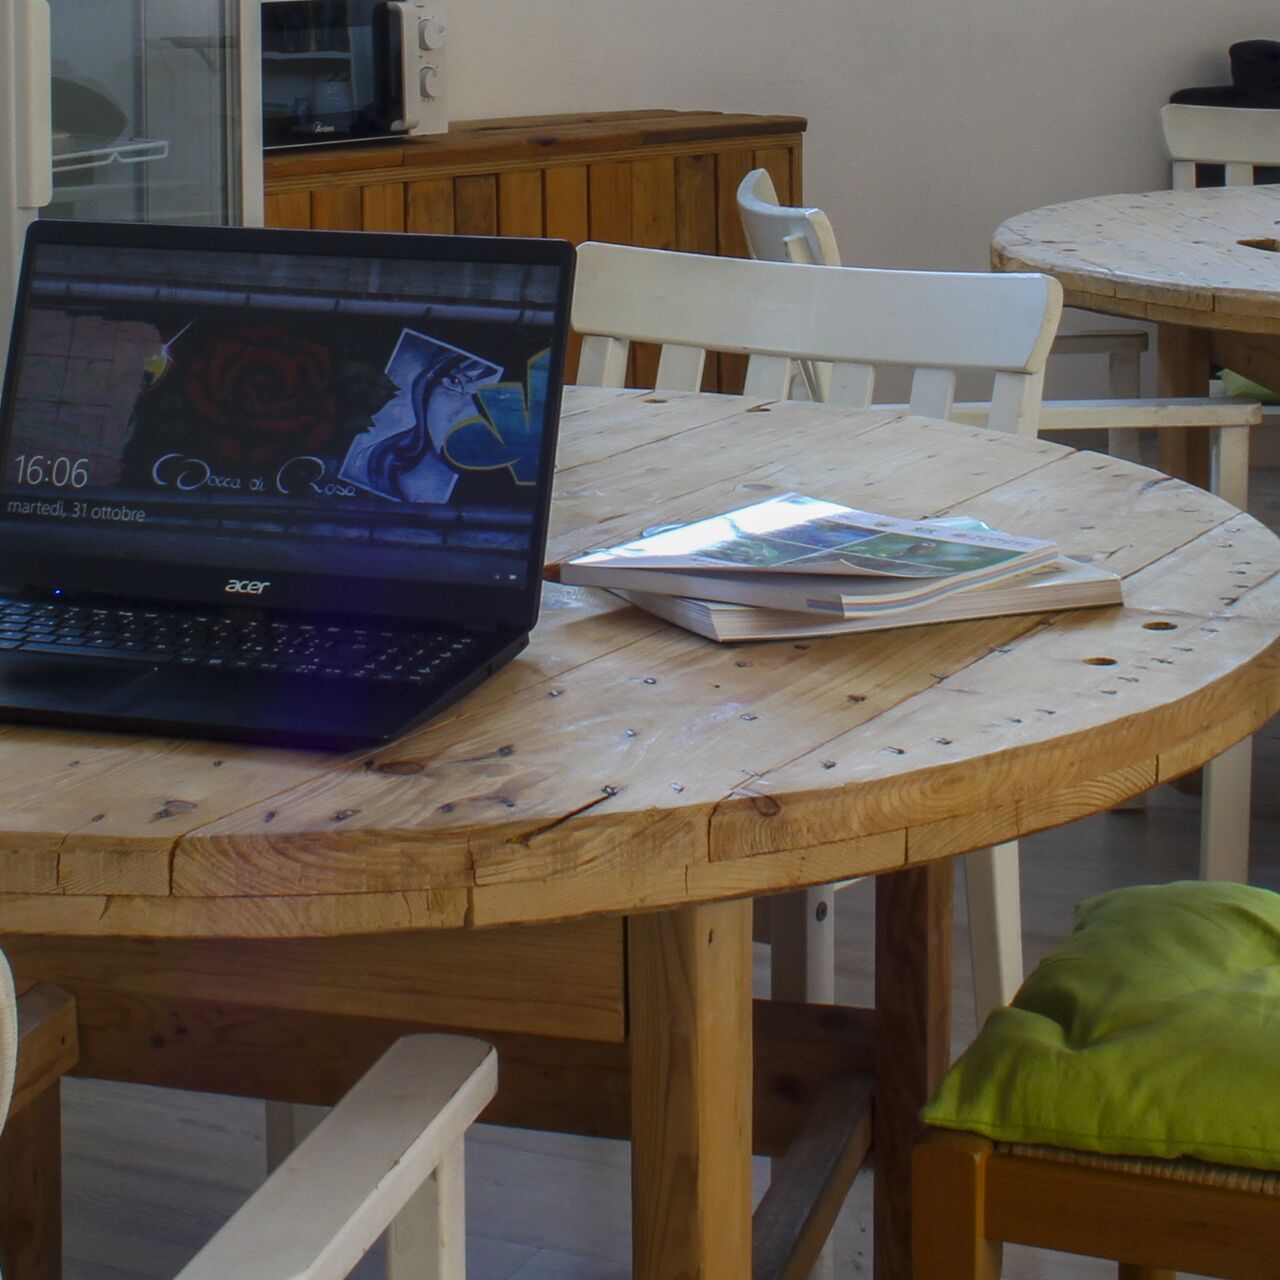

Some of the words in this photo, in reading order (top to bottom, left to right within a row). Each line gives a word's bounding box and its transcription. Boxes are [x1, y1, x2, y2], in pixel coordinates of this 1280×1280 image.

[16, 453, 89, 489] 16:06
[276, 455, 357, 497] Rosa
[71, 502, 87, 518] 31
[90, 505, 146, 522] ottobre
[225, 578, 271, 595] acer
